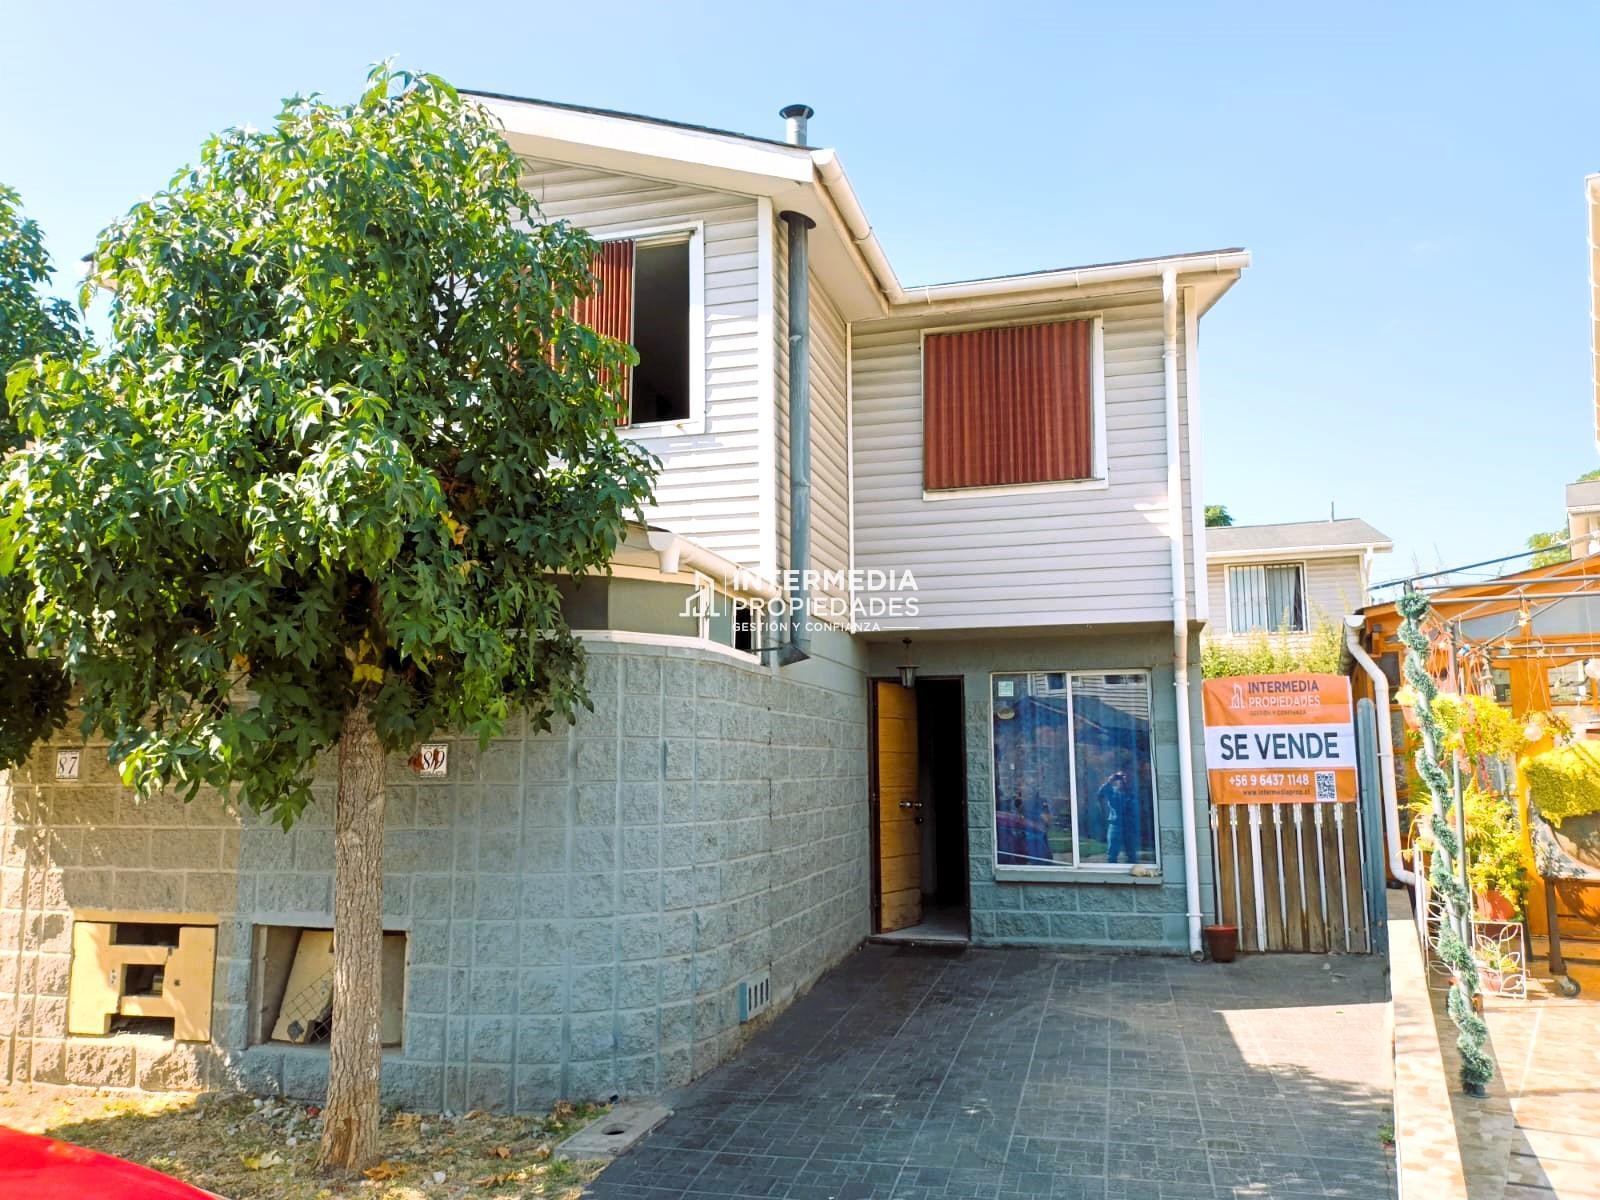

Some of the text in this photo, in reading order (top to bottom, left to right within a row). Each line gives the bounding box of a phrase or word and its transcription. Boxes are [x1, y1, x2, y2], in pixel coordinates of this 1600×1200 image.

[1247, 680, 1320, 694] INTERMEDIA
[1248, 695, 1320, 708] PROPIEDADES
[1220, 731, 1340, 761] SE VENDE
[1229, 774, 1310, 787] +56 9 6437 1148
